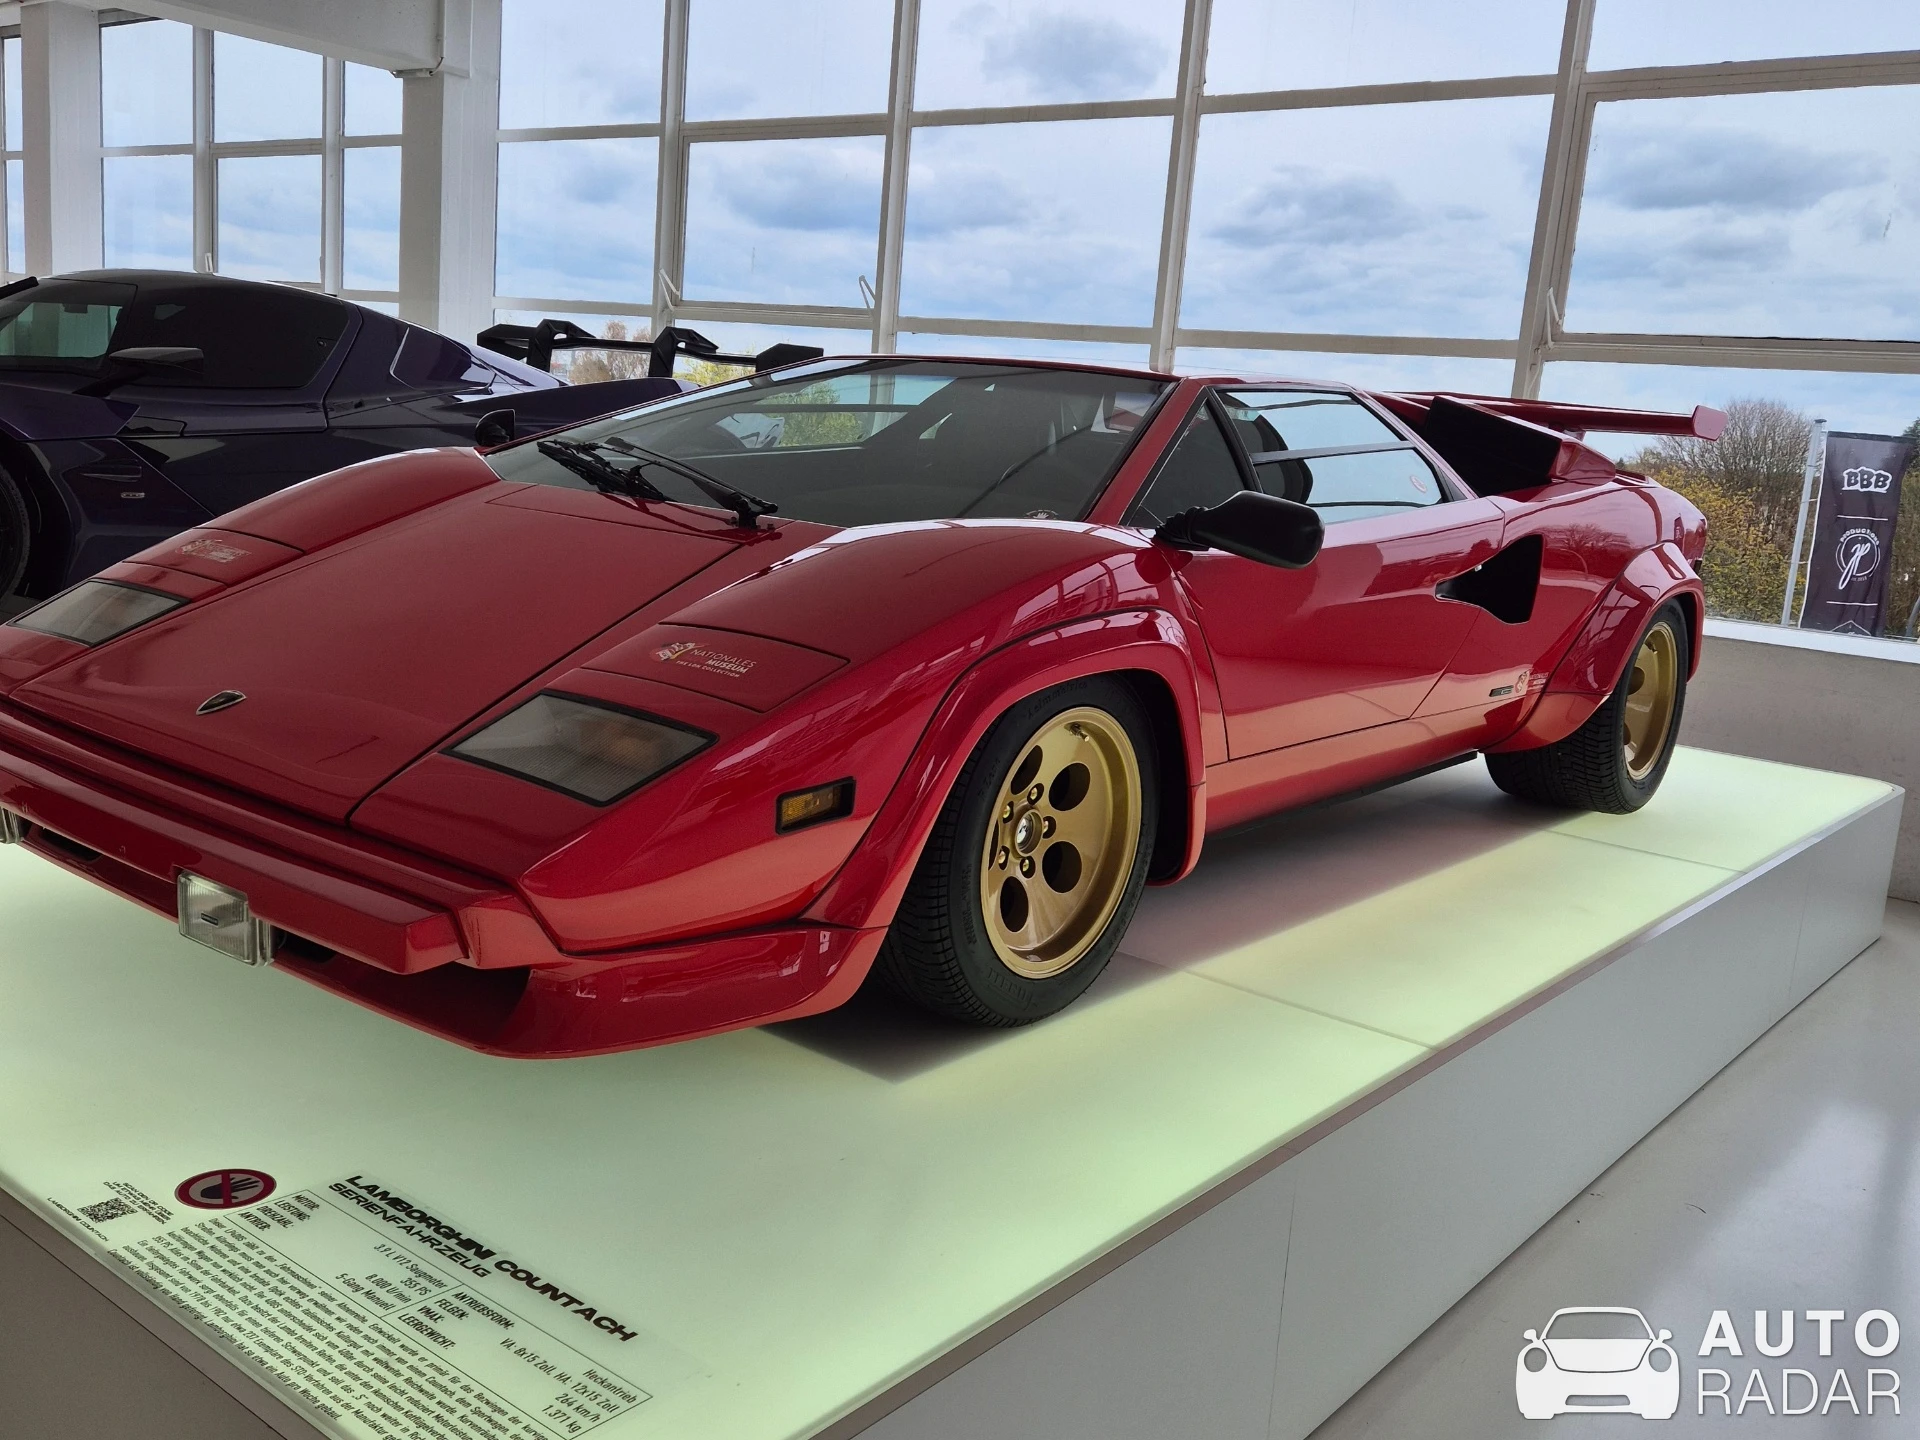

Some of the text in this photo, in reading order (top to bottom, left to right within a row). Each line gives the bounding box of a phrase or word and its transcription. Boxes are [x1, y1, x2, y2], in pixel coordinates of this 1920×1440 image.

[1842, 466, 1892, 493] BBB
[1840, 528, 1880, 546] PRODUCTIONS
[690, 649, 756, 668] NATIONALES
[705, 659, 749, 674] MUSEUM
[702, 665, 740, 678] COLLECTION
[273, 1199, 310, 1222] LEISTUNG:
[291, 1194, 320, 1211] MOTOR:
[237, 1211, 271, 1231] ANTRIEB:
[255, 1205, 294, 1228] DREHZAHL:
[328, 1182, 492, 1278] SERIENFAHRZEUG
[344, 1175, 638, 1342] LAMBORGHINI COUNTACH
[391, 1254, 412, 1266] V12
[405, 1263, 448, 1289] Saugmotor
[399, 1277, 421, 1289] 355
[335, 1273, 396, 1311] 5-Gang Manuell
[385, 1286, 412, 1304] U/min
[416, 1305, 445, 1324] VMAX:
[433, 1298, 469, 1320] FELGEN:
[451, 1291, 515, 1330] ANTRIEBSFORM:
[397, 1312, 456, 1350] LEERGEWICHT:
[499, 1337, 620, 1413] VA: 8x15 Zoll, HA: 12x15 Zoll
[582, 1368, 637, 1404] Heckantrieb
[541, 1404, 582, 1434] 1.371 kg
[554, 1392, 600, 1423] 264 km/h
